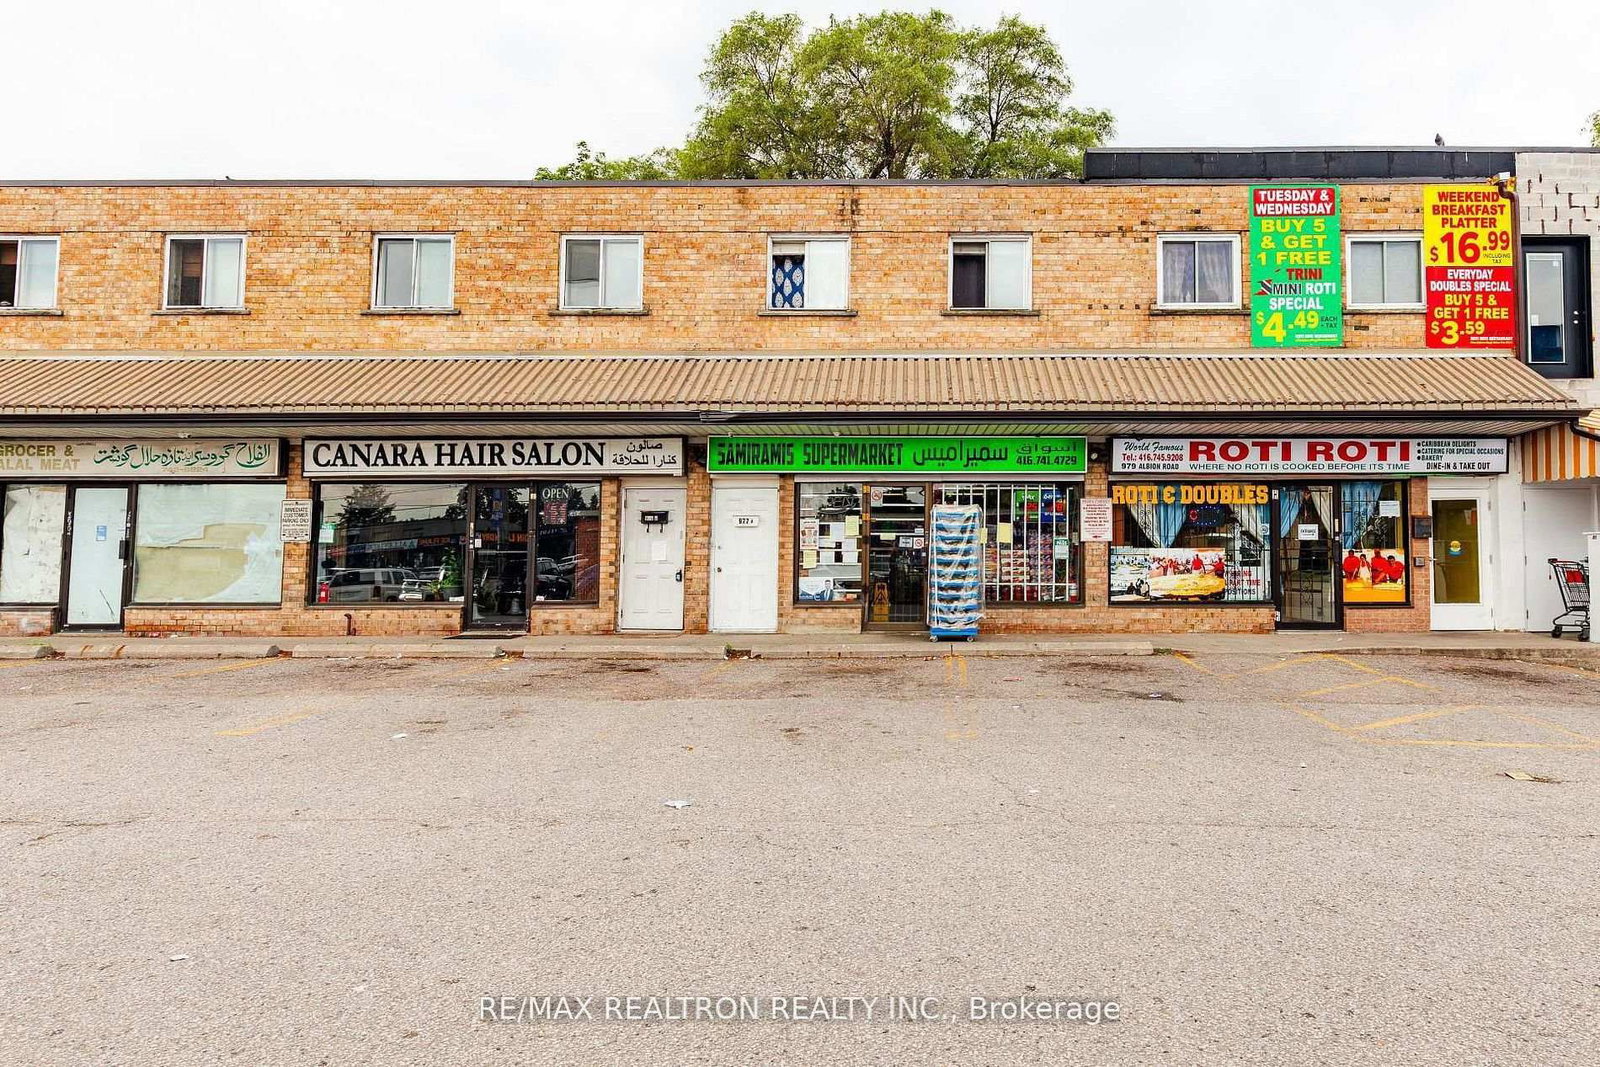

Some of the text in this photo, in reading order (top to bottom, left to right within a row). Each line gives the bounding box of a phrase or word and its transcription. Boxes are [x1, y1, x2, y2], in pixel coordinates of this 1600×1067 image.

[1259, 190, 1329, 201] TUESDAY &
[1438, 191, 1499, 203] WEEKEND
[1256, 203, 1332, 215] WEDNESDAY
[1432, 204, 1505, 215] BREAKFAST
[1262, 219, 1325, 232] BUY 5
[1441, 217, 1497, 228] PLATTER
[1261, 235, 1327, 249] & GET
[1257, 251, 1331, 265] 1 FREE
[1286, 268, 1322, 280] TRINI
[1447, 269, 1493, 279] EVERYDAY
[1273, 282, 1336, 295] MINI ROTI
[1430, 281, 1511, 291] DOUBLES SPECIAL
[1269, 297, 1324, 310] SPECIAL
[1445, 294, 1497, 305] BUY 5 &
[1434, 307, 1509, 319] GET 1 FREE
[64, 445, 73, 456] &
[626, 440, 662, 452] صالون
[1123, 441, 1184, 453] World Famous
[1189, 440, 1410, 462] ROTI ROTI
[313, 441, 606, 467] CANARA HAIR SALON
[612, 453, 677, 467] كنارا للحلاقة
[717, 443, 904, 466] SAMIRAMIS SUPERMARKET
[912, 440, 1008, 468] سميراميس
[1122, 453, 1184, 462] Tel.: 416.745.9208
[40, 459, 80, 470] MEAT
[1016, 455, 1077, 466] 416.741.4729
[542, 488, 569, 499] OPEN
[1112, 485, 1158, 504] ROTI
[1180, 485, 1269, 505] DOUBLES
